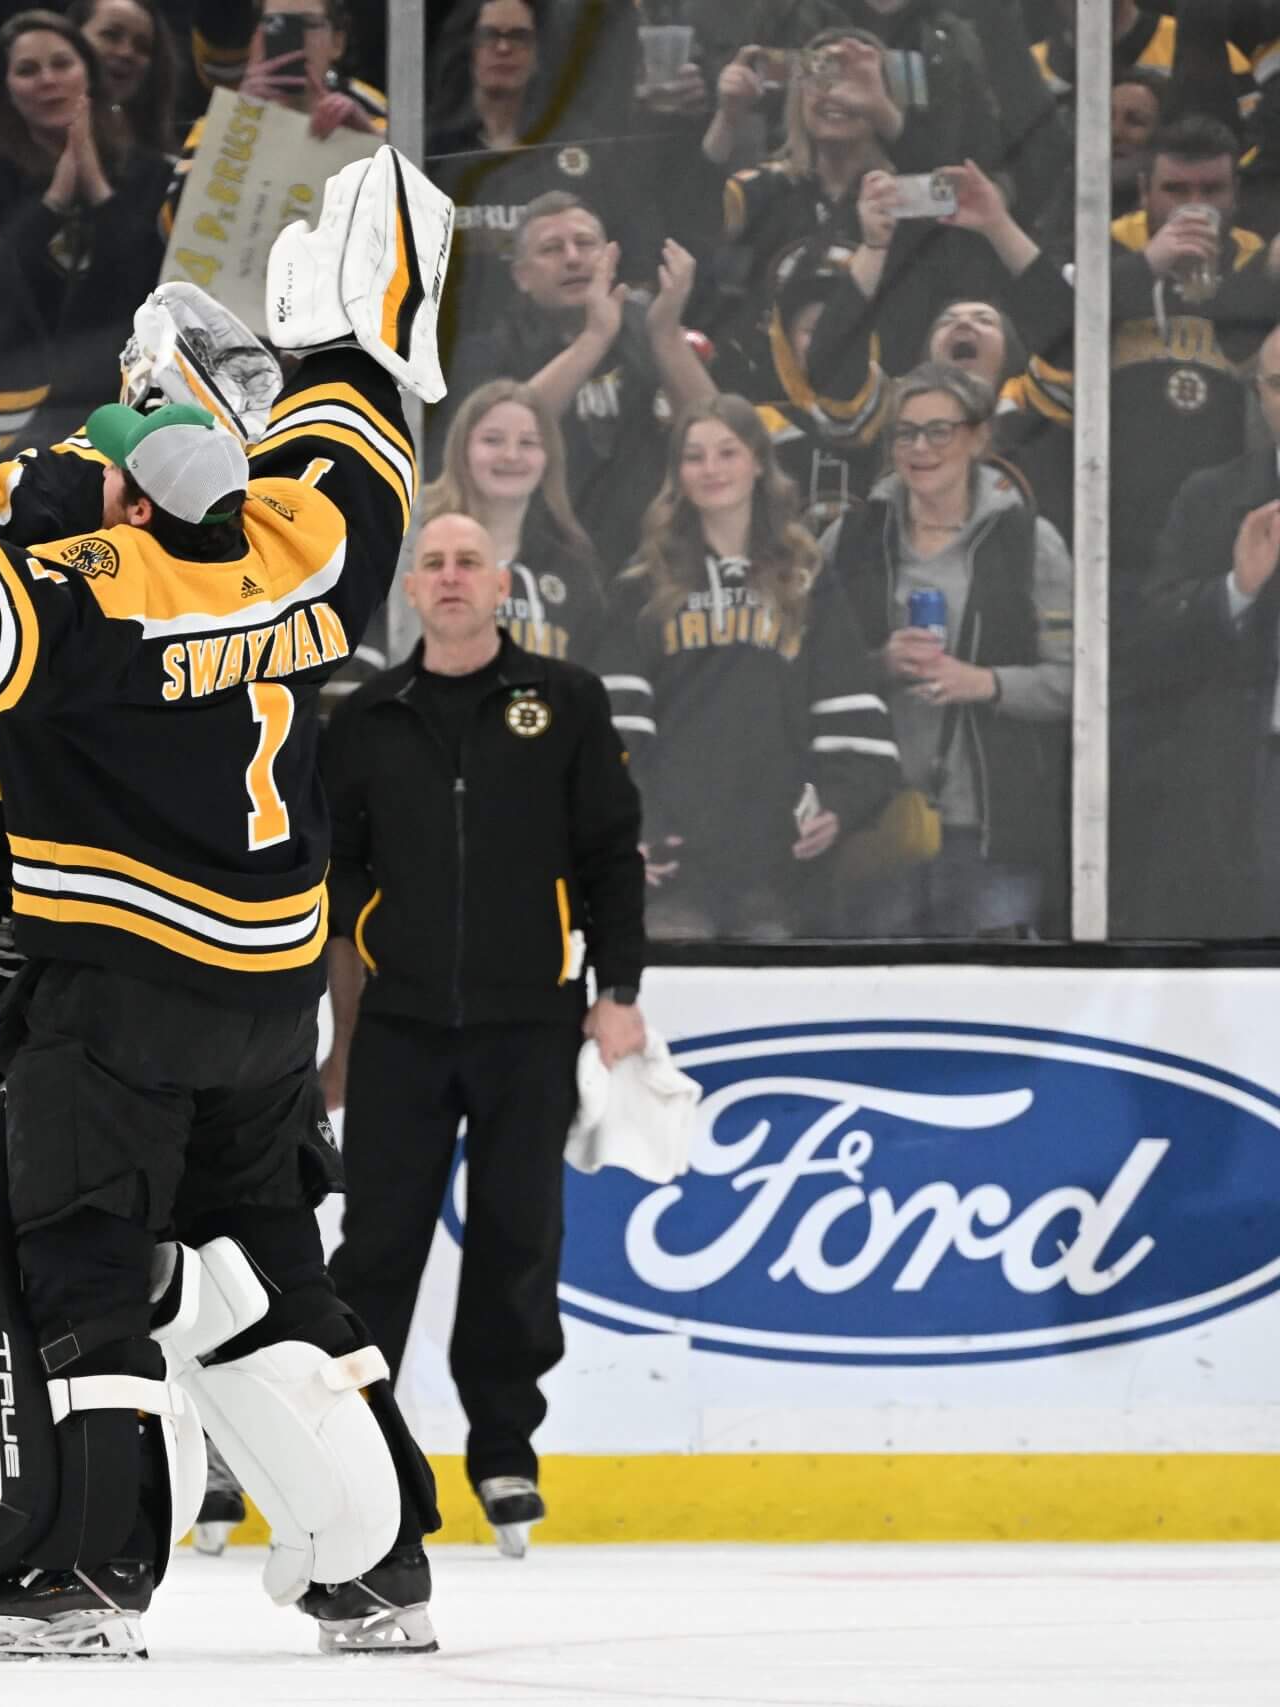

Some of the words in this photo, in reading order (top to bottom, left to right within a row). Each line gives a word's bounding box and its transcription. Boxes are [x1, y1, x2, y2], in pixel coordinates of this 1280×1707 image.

[431, 206, 452, 304] TRUE
[241, 586, 264, 599] adidas
[161, 602, 350, 701] SWAYMAN
[245, 681, 295, 852] 1
[624, 1075, 1172, 1295] Ford
